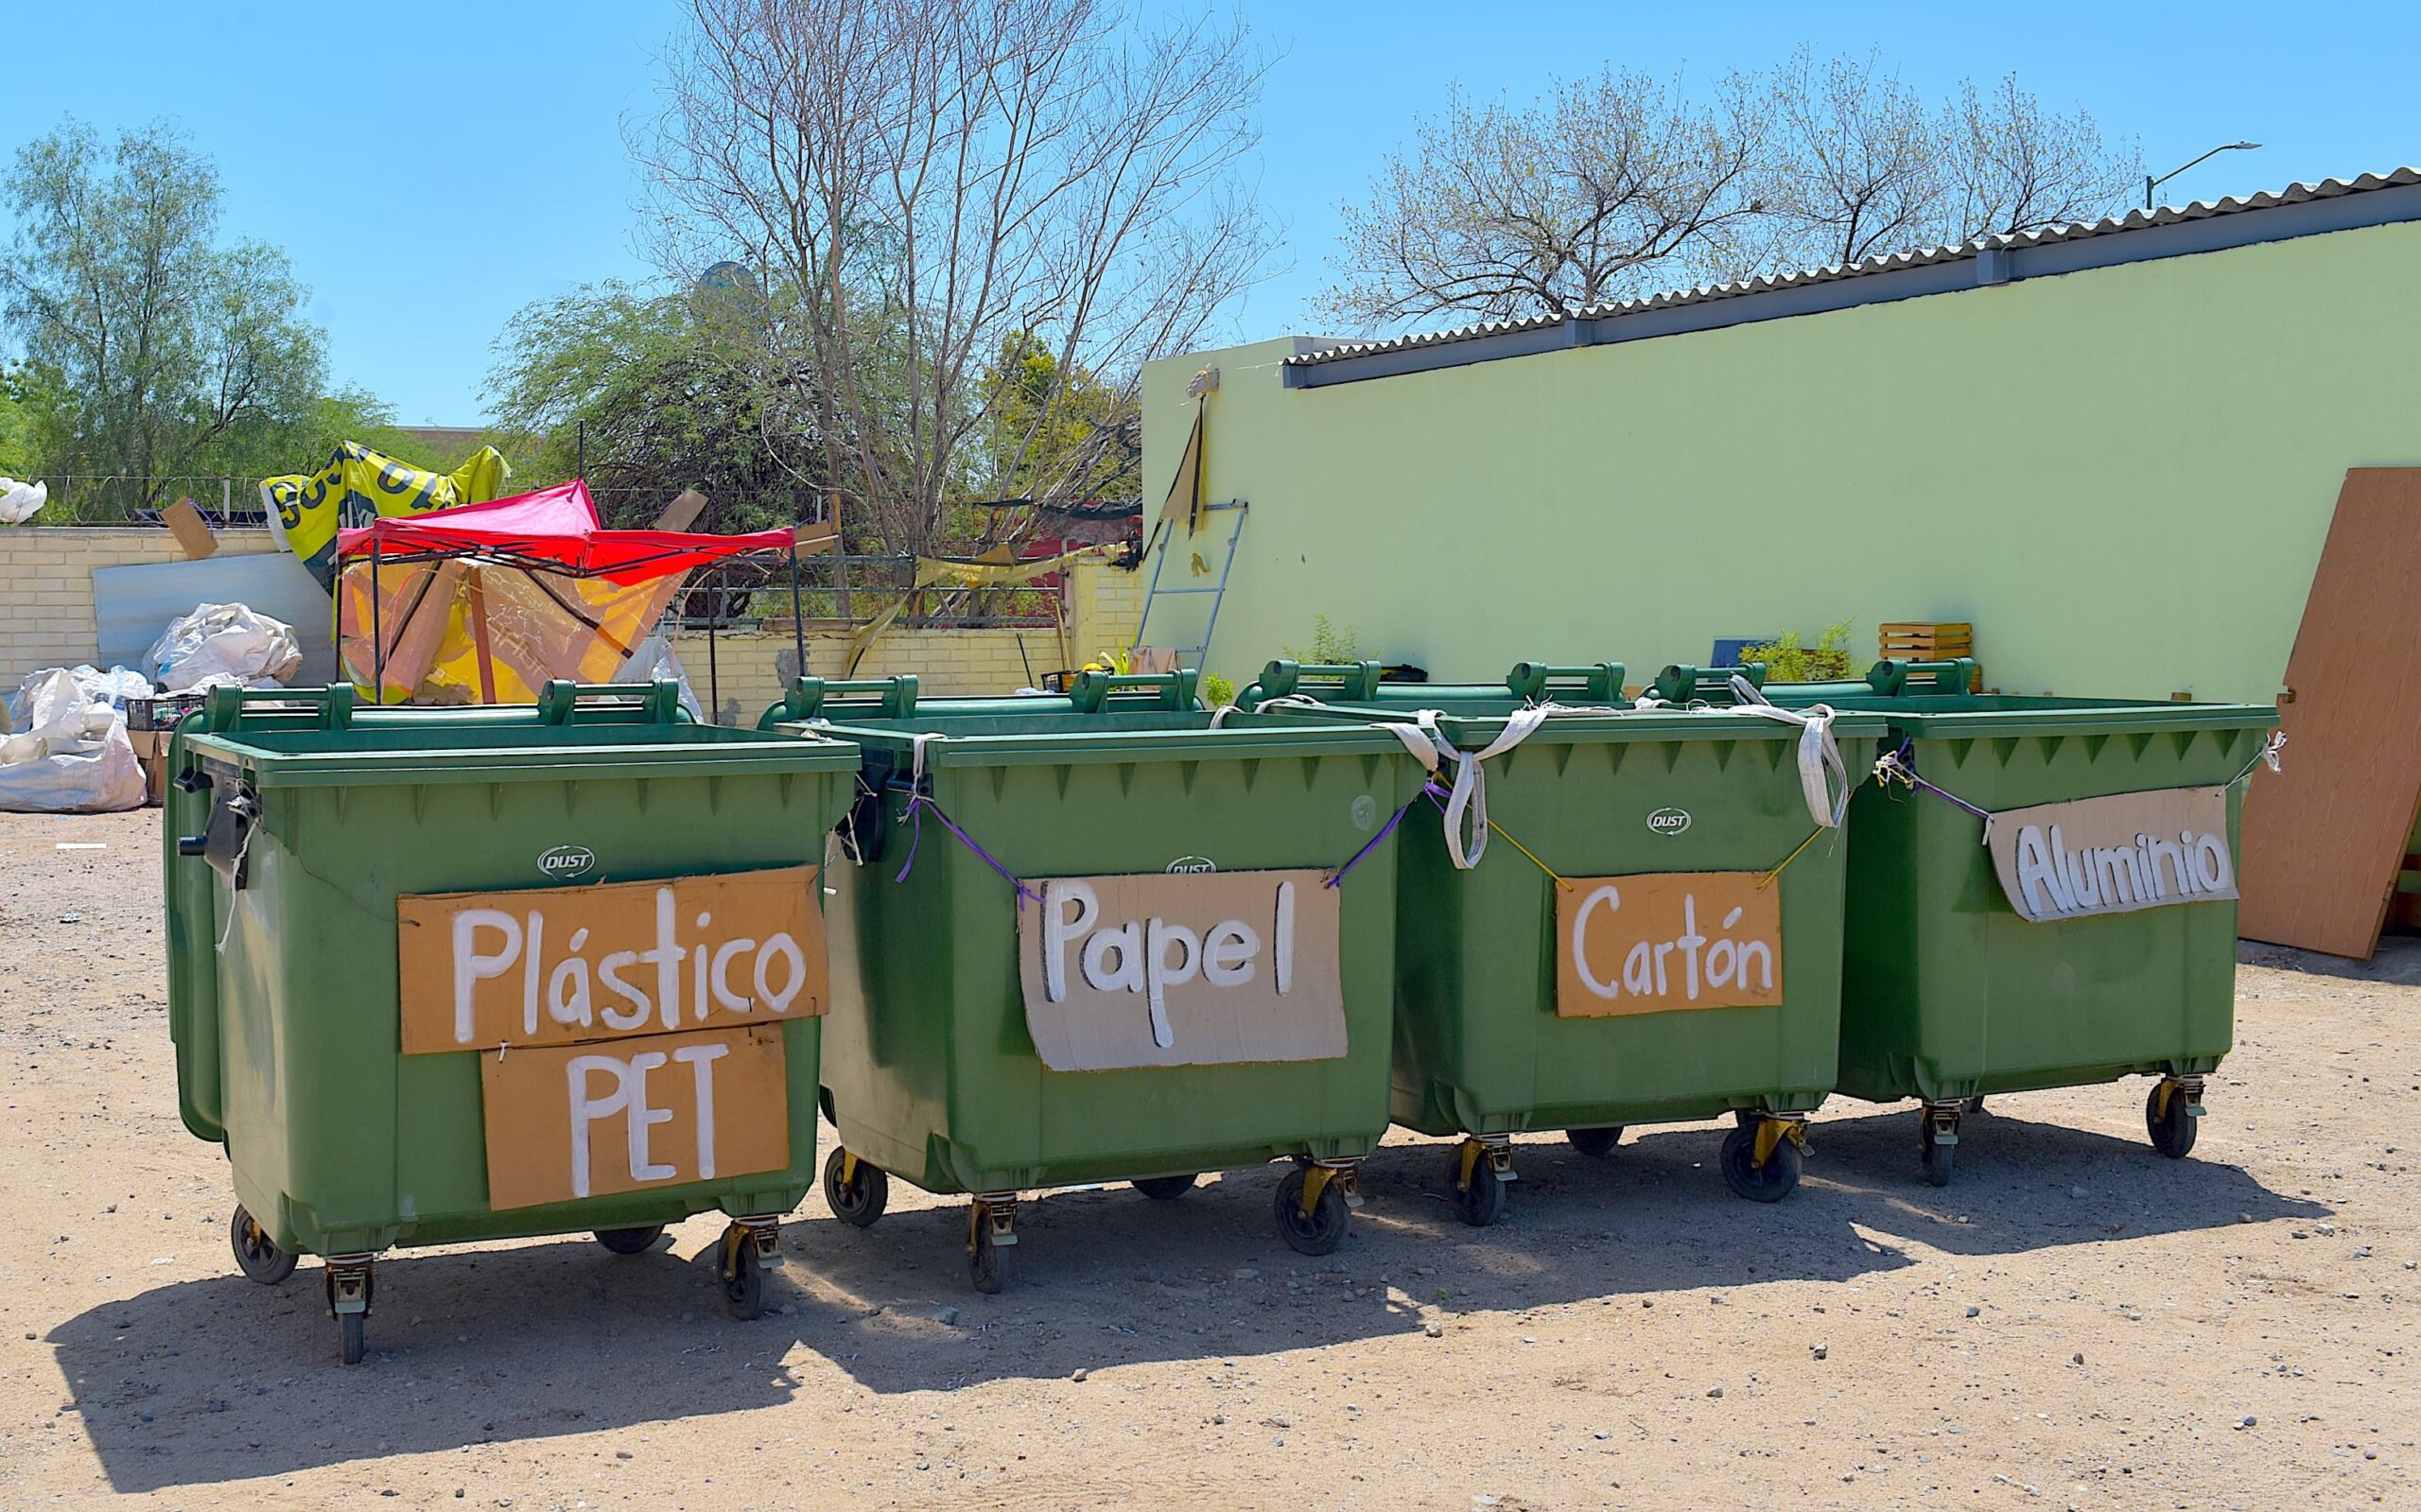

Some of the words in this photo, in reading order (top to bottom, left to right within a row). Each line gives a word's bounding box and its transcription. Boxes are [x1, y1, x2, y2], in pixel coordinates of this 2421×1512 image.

[546, 854, 590, 869] DUST
[1652, 815, 1685, 827] DUST
[2015, 825, 2228, 917] Aluminio
[452, 888, 807, 1043] Plástico
[1040, 880, 1295, 1049] Papel
[1573, 885, 1772, 999] Cartón
[567, 1043, 729, 1198] PET
